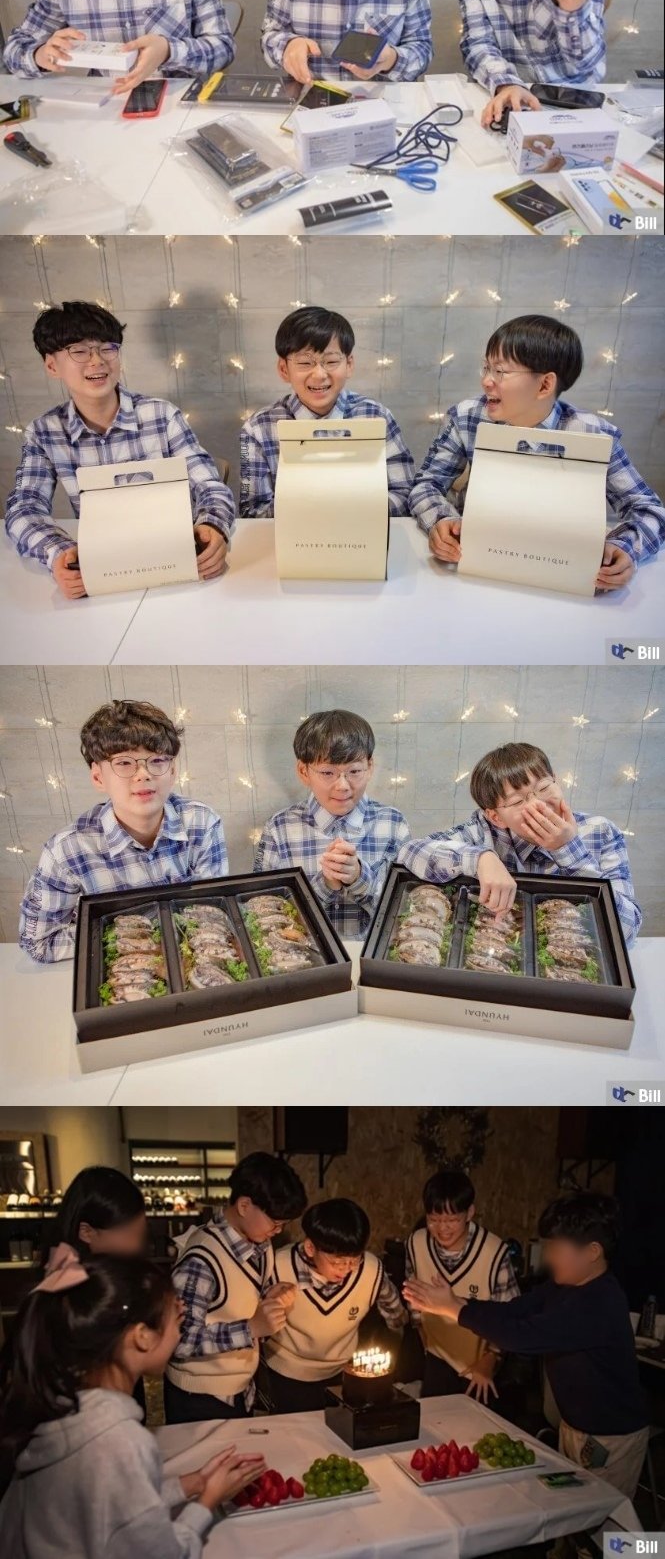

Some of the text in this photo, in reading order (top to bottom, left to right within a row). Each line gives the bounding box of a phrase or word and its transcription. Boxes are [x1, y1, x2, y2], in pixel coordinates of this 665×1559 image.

[487, 547, 569, 566] PASTRY BOUTIQUE
[103, 563, 176, 578] PASTRY BOUTIQUE
[465, 1008, 510, 1021] HYUNDAI
[203, 1021, 249, 1037] HYUNDAI
